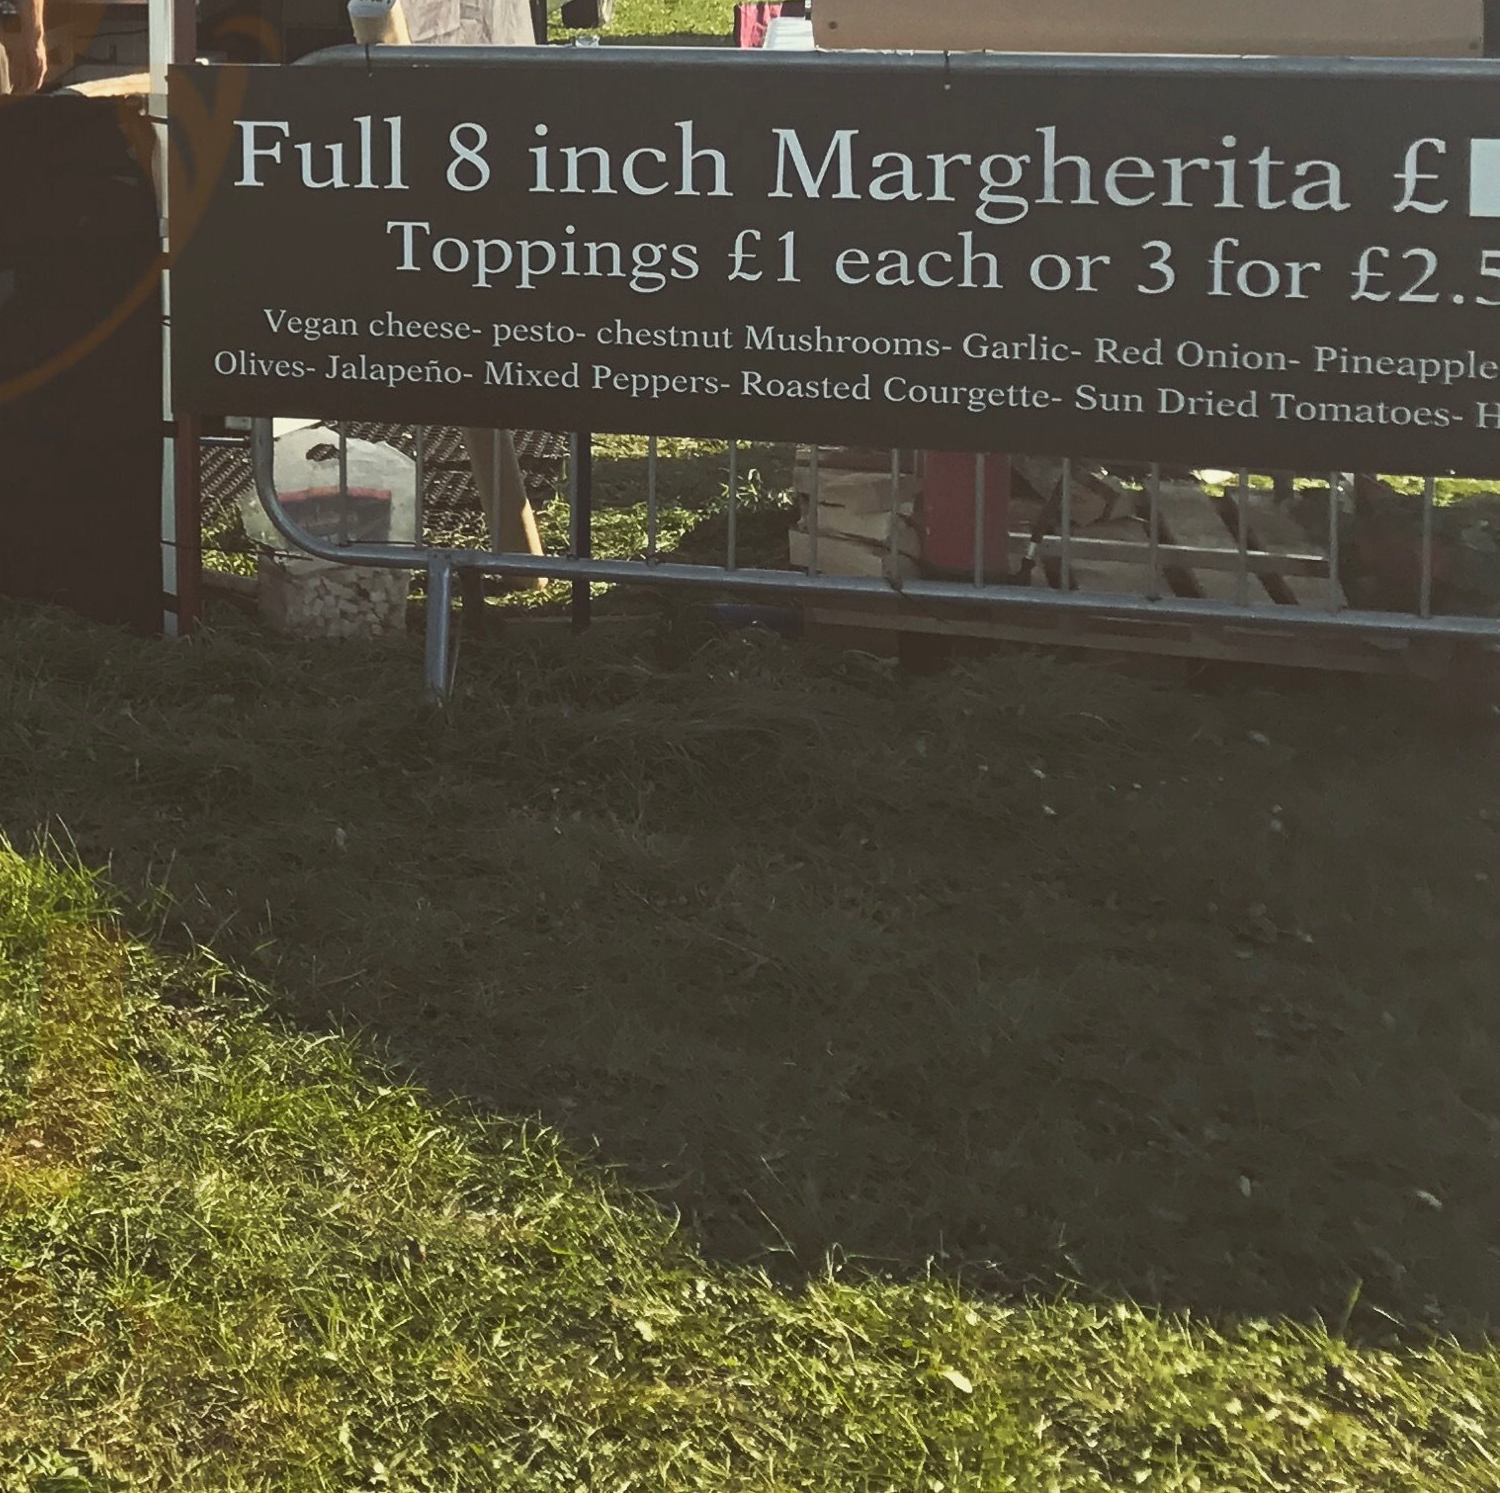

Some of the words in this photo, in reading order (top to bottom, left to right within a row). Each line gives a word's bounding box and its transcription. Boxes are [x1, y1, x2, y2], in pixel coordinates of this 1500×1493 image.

[234, 116, 409, 189] Full
[447, 123, 490, 191] 8
[529, 120, 733, 196] inch
[767, 126, 1350, 225] Margherita
[1393, 138, 1448, 213] £
[387, 222, 698, 292] Toppings
[728, 230, 800, 282] £1
[835, 231, 1003, 288] each
[1030, 255, 1110, 291] or
[1138, 241, 1174, 293] 3
[1208, 238, 1321, 298] for
[264, 309, 358, 340] Vegan
[370, 311, 481, 339] cheese-
[493, 322, 585, 346] pesto-
[597, 319, 732, 348] chestnut
[745, 325, 951, 356] Mushrooms-
[963, 333, 1081, 361] Garlic-
[1095, 338, 1163, 365] Red
[1177, 341, 1300, 370] Onion-
[1315, 346, 1498, 384] Pineapple
[215, 350, 315, 377] Olives-
[326, 355, 472, 387] Jalapeño-
[485, 361, 579, 387] Mixed
[592, 365, 730, 398] Peppers-
[741, 371, 870, 400] Roasted
[884, 377, 1062, 412] Courgette-
[1076, 385, 1143, 412] Sun
[1158, 388, 1258, 417] Dried
[1271, 393, 1463, 426] Tomatoes-
